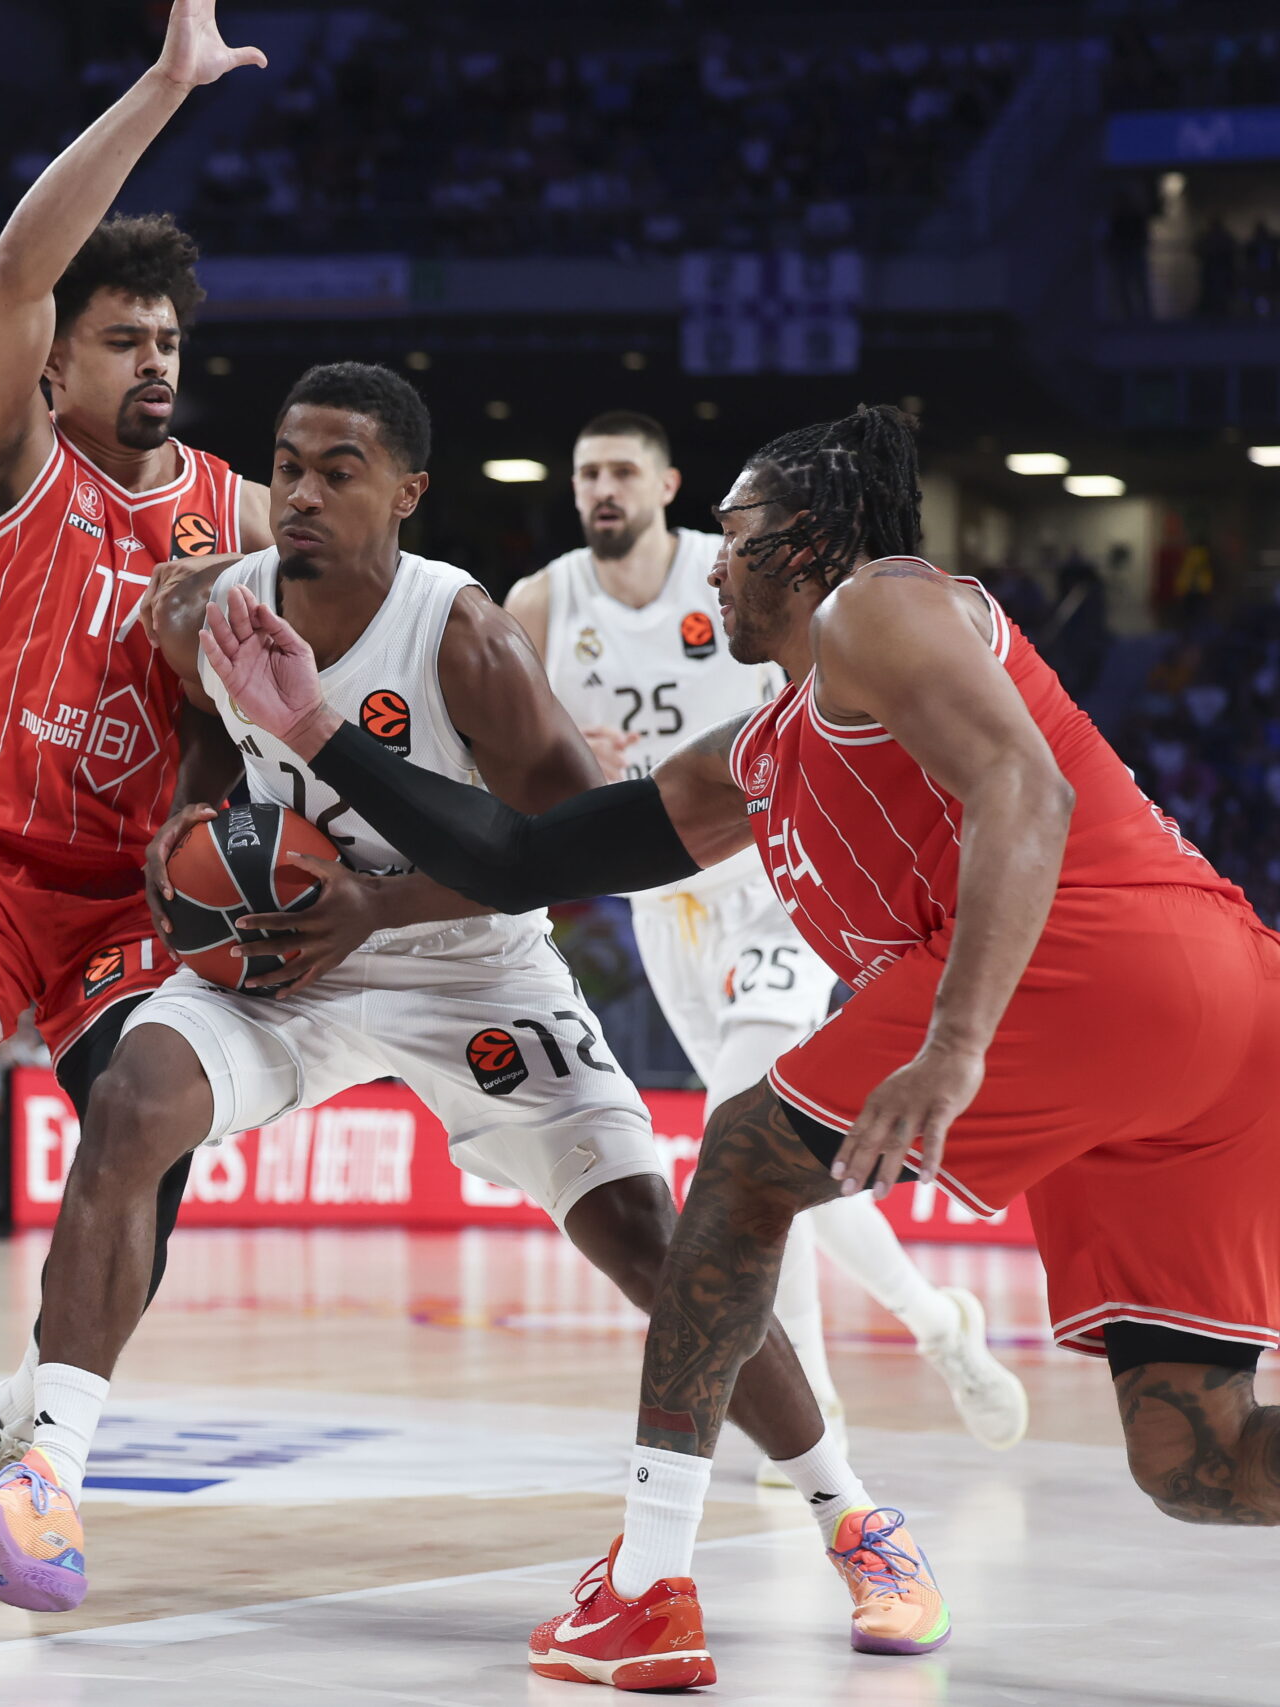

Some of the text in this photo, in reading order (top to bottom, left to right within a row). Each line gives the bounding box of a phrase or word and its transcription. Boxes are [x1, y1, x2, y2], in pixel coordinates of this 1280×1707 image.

[67, 512, 103, 538] RTMI
[87, 563, 153, 644] 17
[54, 703, 89, 730] בית
[615, 682, 684, 736] 25
[85, 714, 140, 764] IBI
[746, 797, 769, 816] RTMI
[740, 945, 802, 993] 25
[513, 1011, 616, 1078] 12
[482, 1069, 525, 1091] EuroLeague
